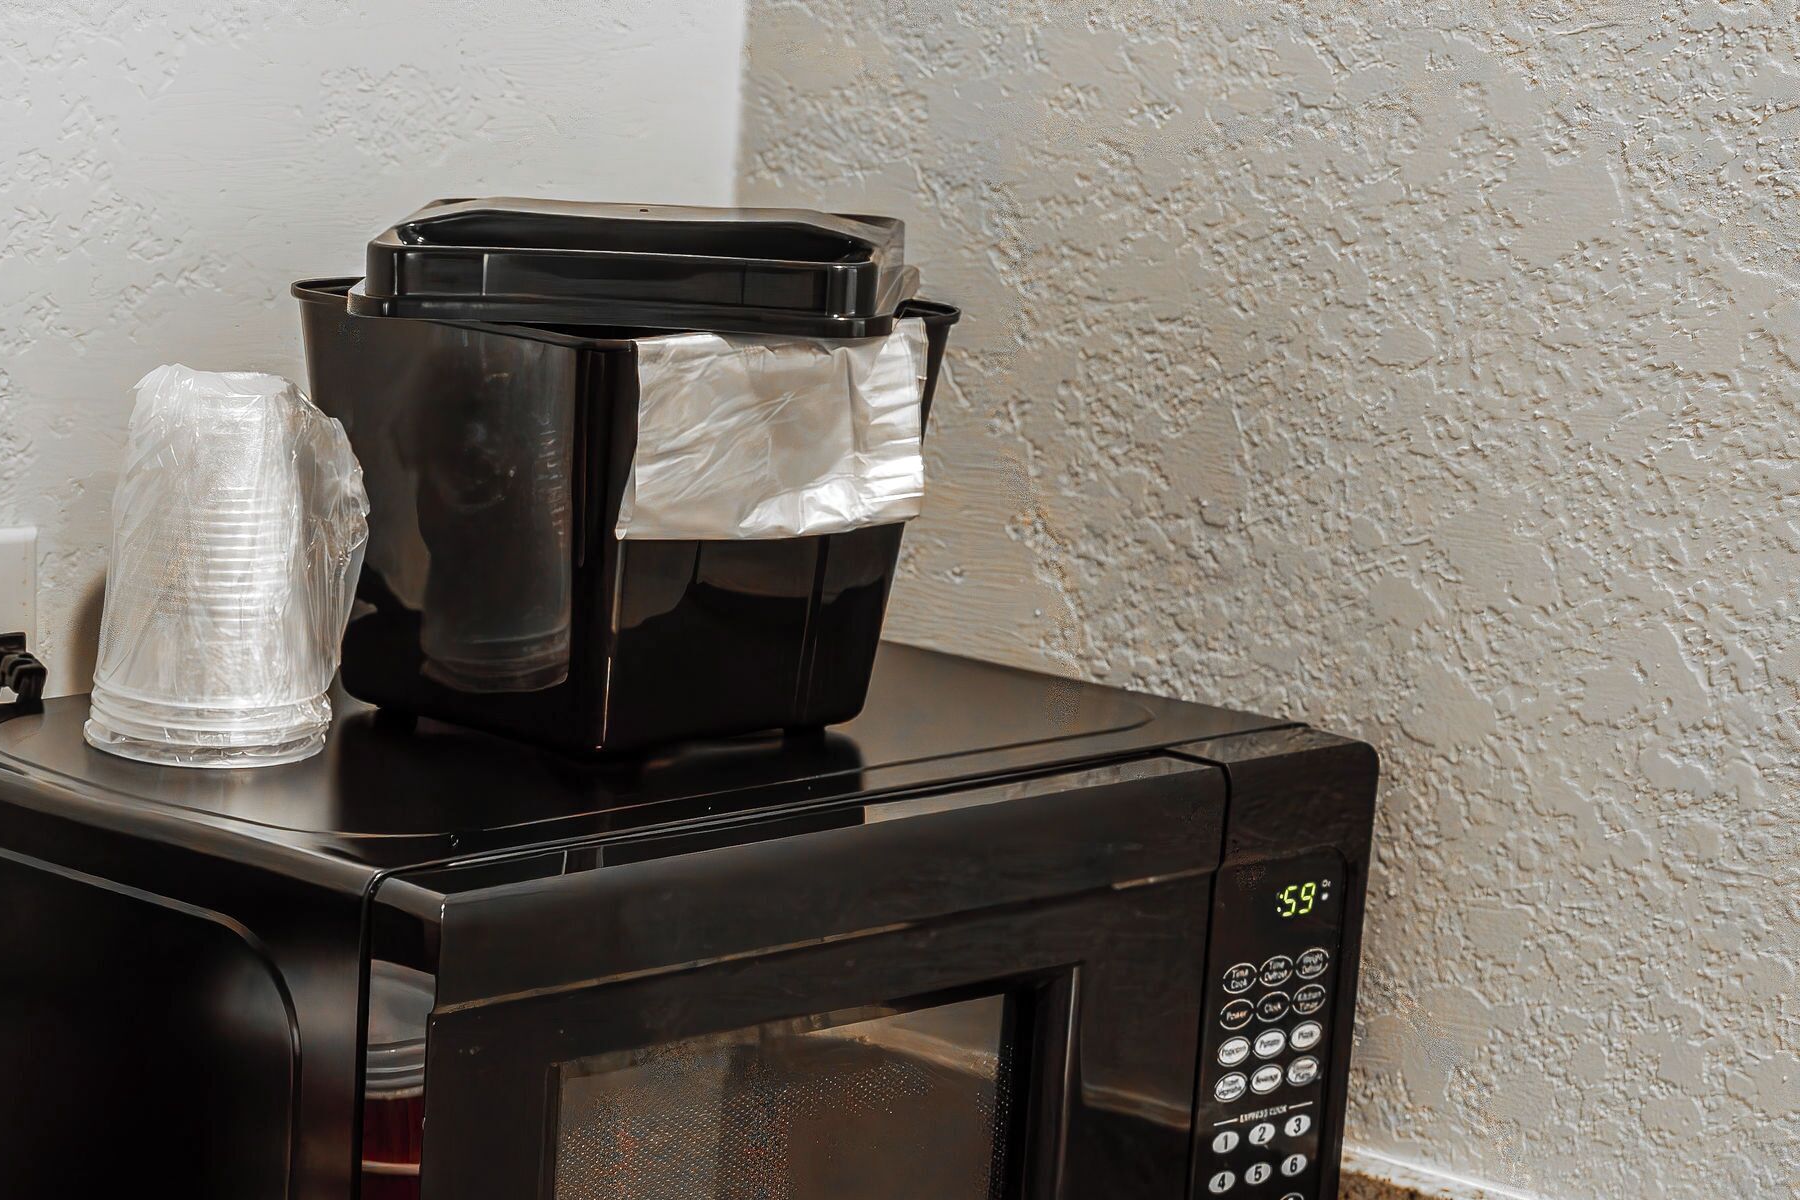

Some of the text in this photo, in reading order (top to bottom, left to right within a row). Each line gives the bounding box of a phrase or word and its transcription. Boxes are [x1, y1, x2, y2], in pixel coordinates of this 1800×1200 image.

[1222, 1117, 1302, 1150] 1 2 3
[1217, 1157, 1298, 1190] 4 5 6
